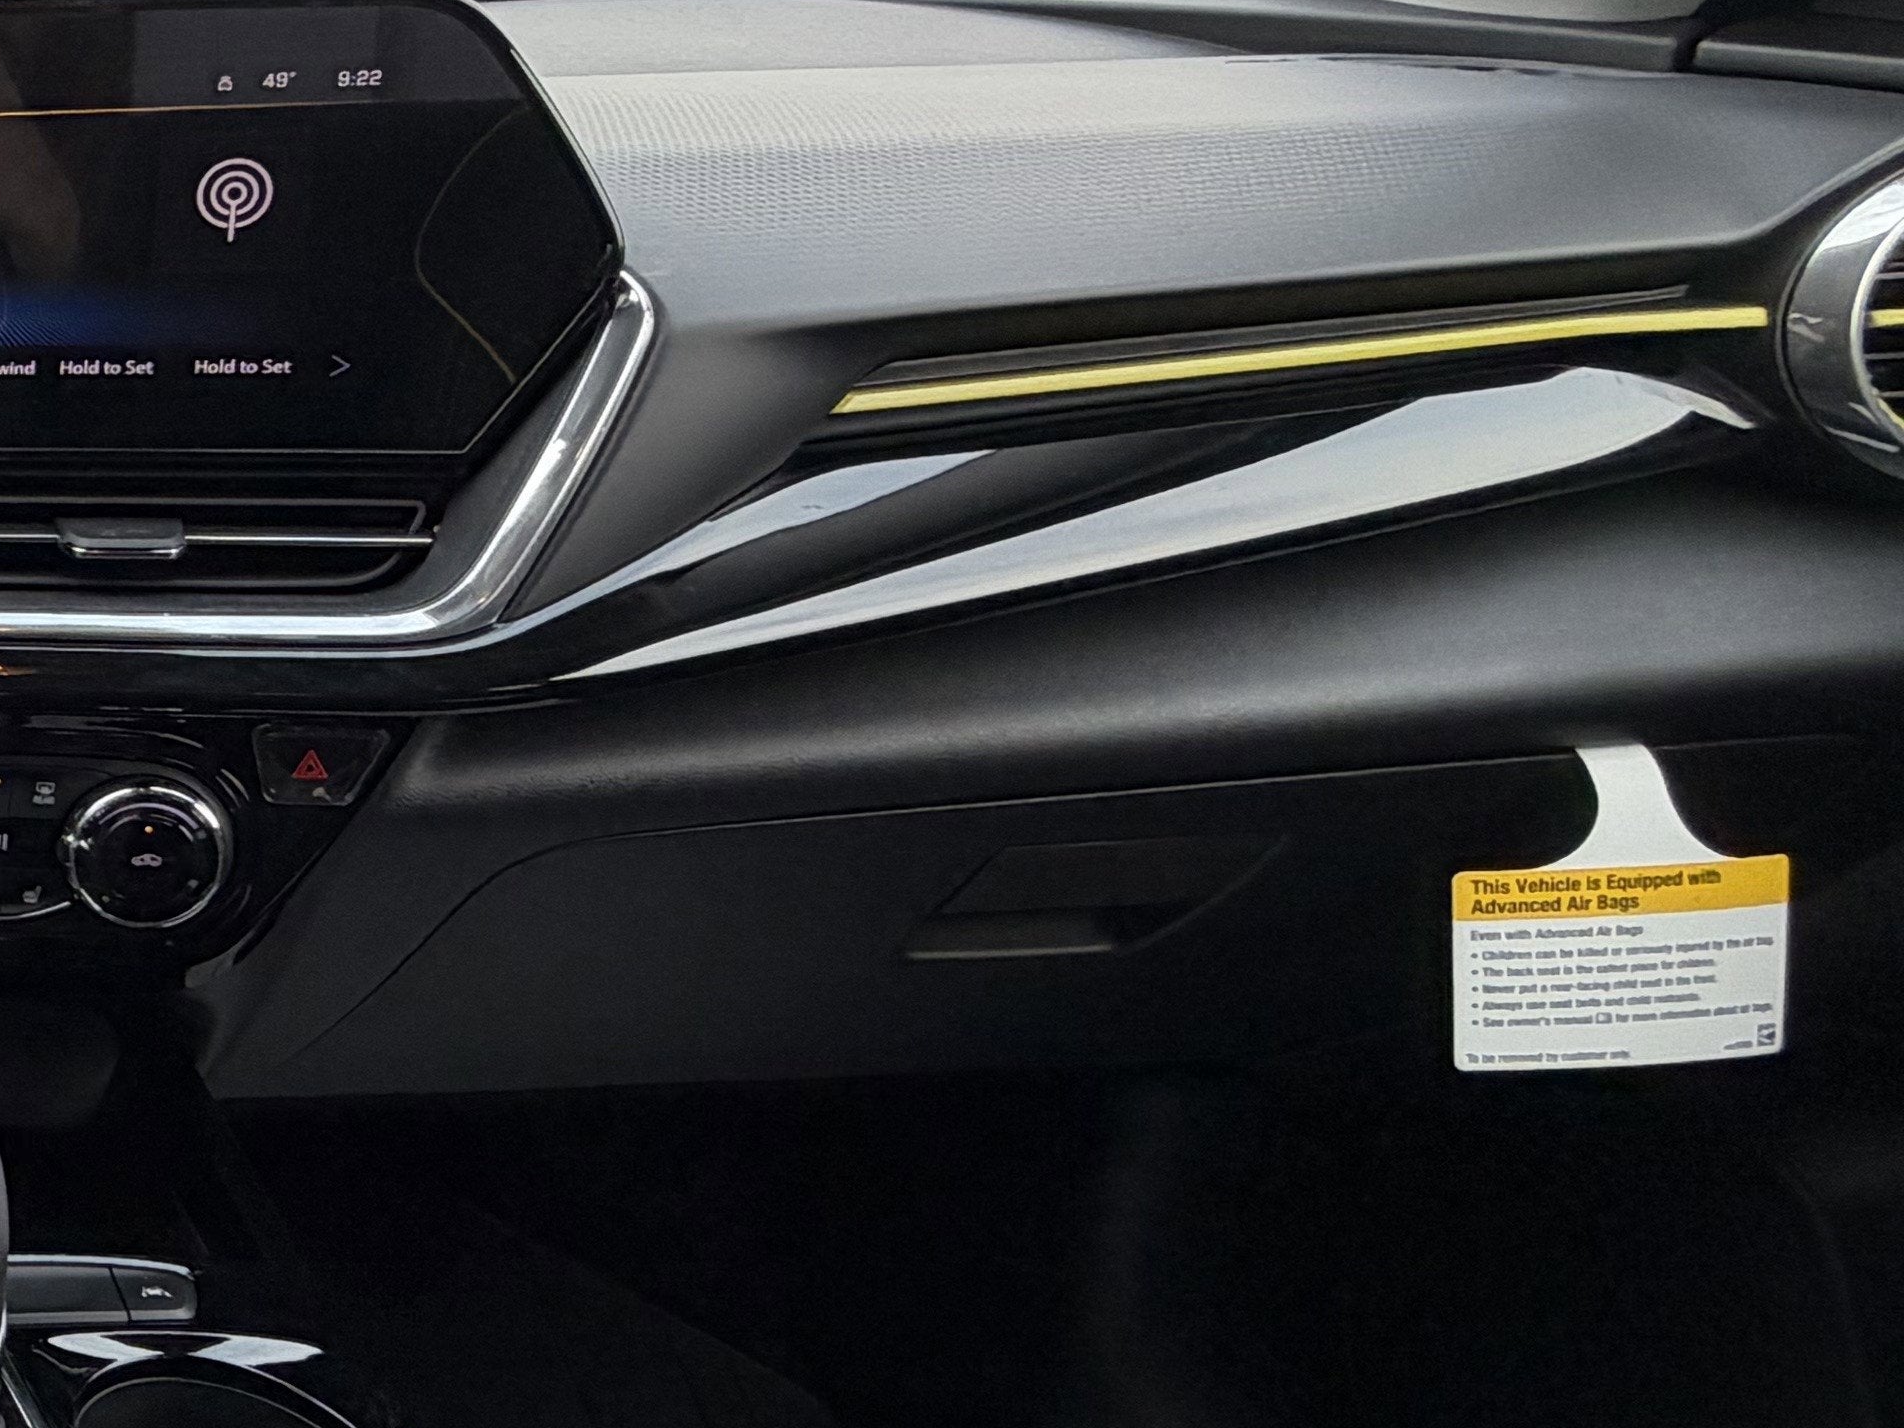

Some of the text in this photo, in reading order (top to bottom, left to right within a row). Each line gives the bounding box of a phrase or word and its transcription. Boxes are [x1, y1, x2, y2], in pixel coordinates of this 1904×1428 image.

[336, 69, 384, 88] 9:22
[59, 360, 155, 376] Hold to Set
[194, 359, 293, 375] Hold to Set
[1471, 878, 1511, 895] This
[1515, 877, 1582, 895] Vehicle
[1606, 871, 1684, 892] Equipped
[1687, 869, 1722, 886] with
[1470, 894, 1641, 915] Advanced Air Bags
